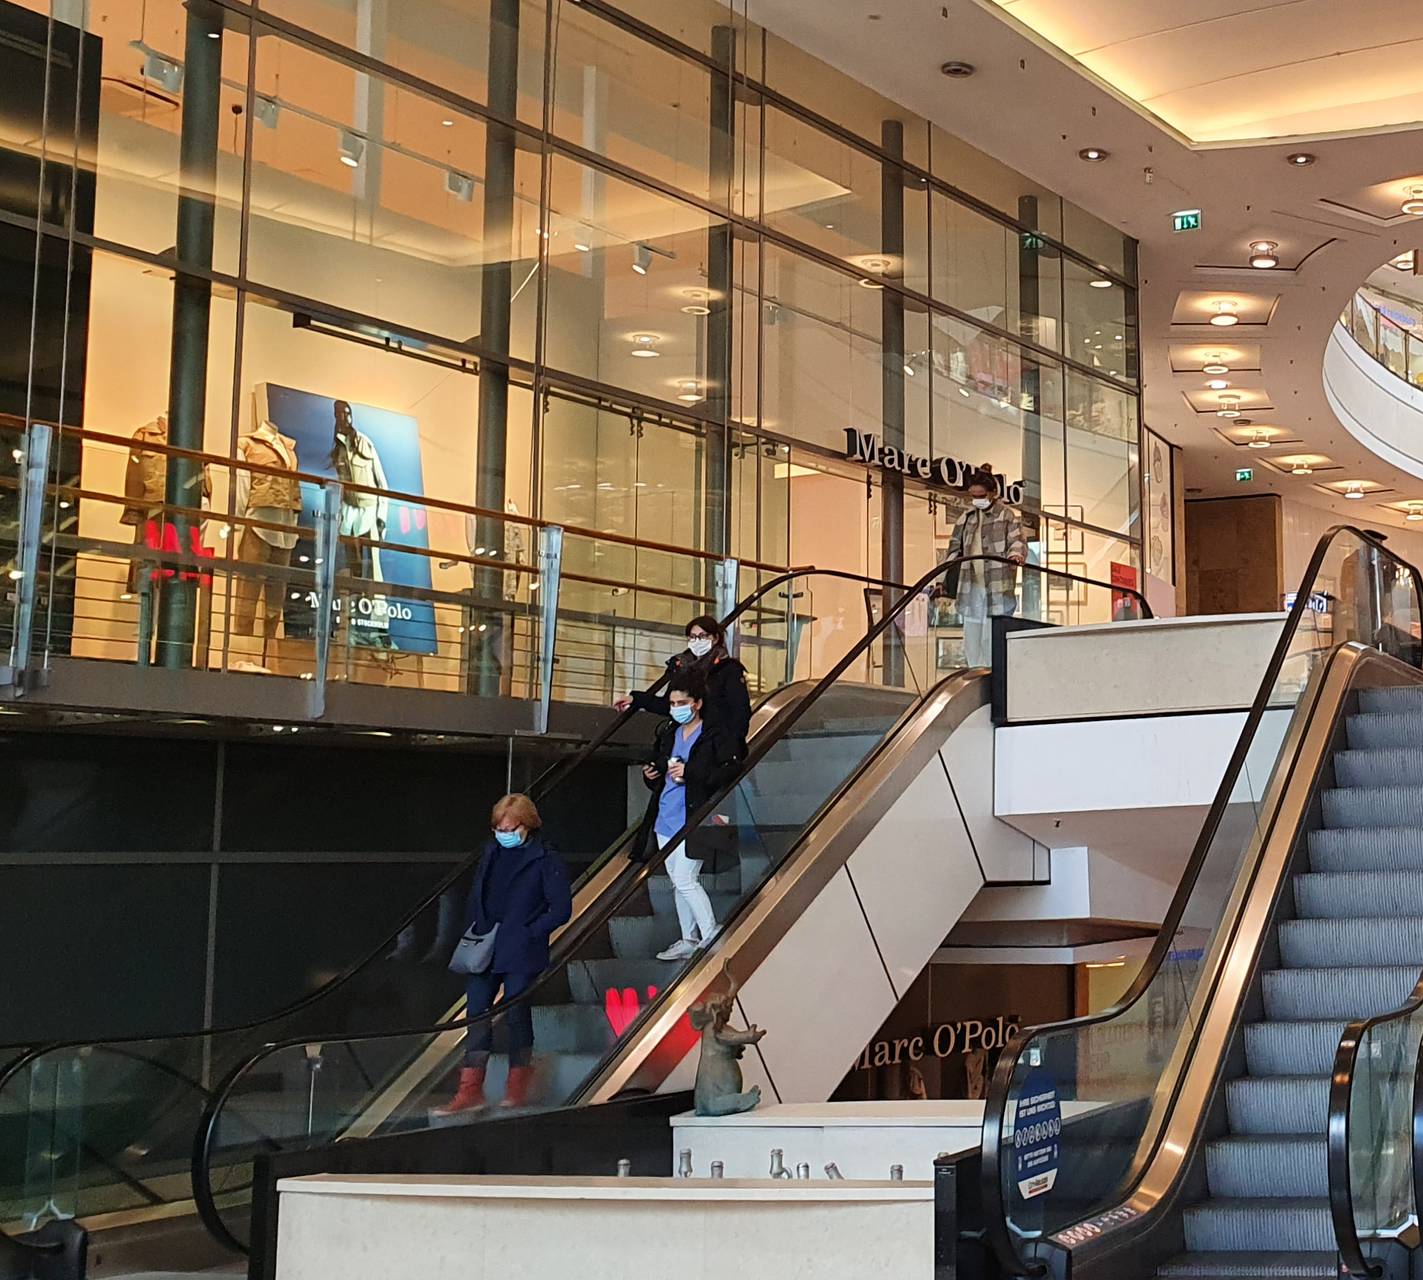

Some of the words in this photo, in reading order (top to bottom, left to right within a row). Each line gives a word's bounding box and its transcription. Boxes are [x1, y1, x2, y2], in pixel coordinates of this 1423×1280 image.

[843, 427, 932, 479] Marc
[940, 457, 1026, 506] O'lo
[933, 1015, 1020, 1058] O'Polo
